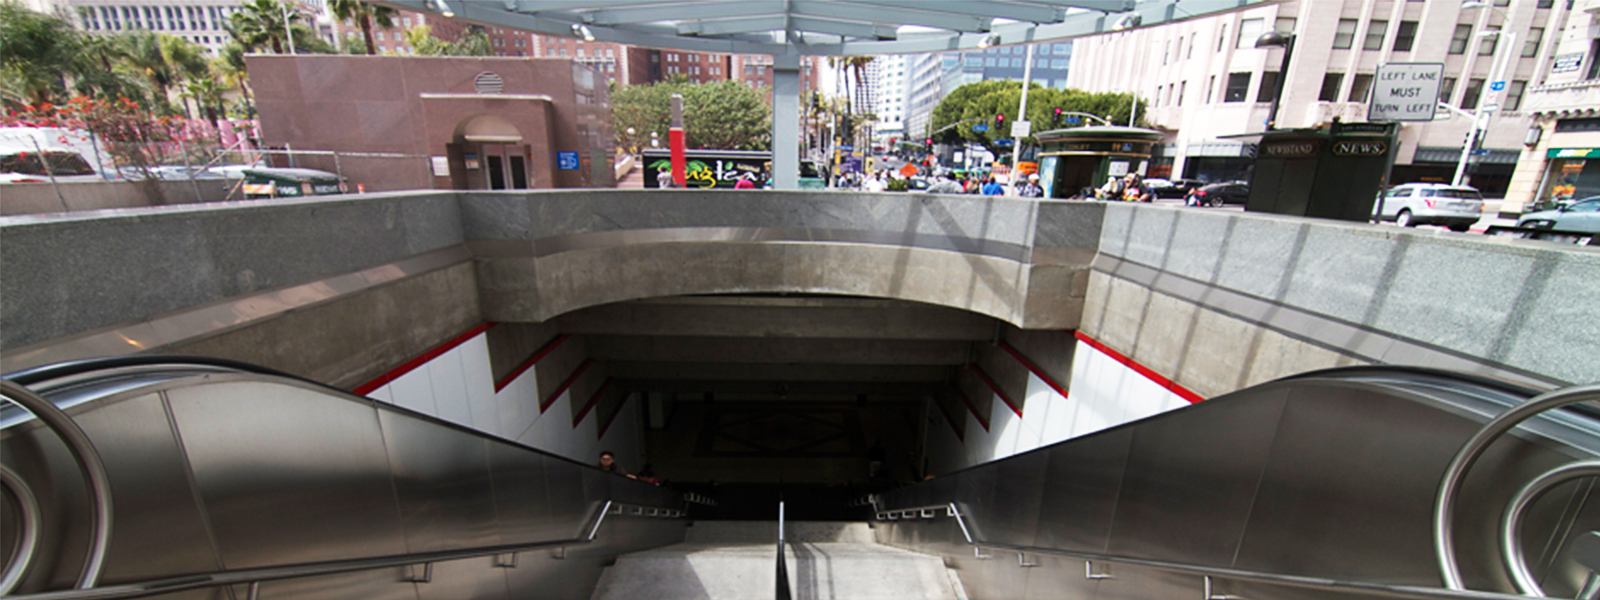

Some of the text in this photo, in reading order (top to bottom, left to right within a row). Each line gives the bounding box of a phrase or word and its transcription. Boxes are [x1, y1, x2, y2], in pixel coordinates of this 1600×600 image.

[1381, 71, 1438, 81] LEFT LANE
[1390, 87, 1421, 98] MUST
[1375, 103, 1431, 113] TURN LEFT
[1339, 142, 1382, 155] NEWS
